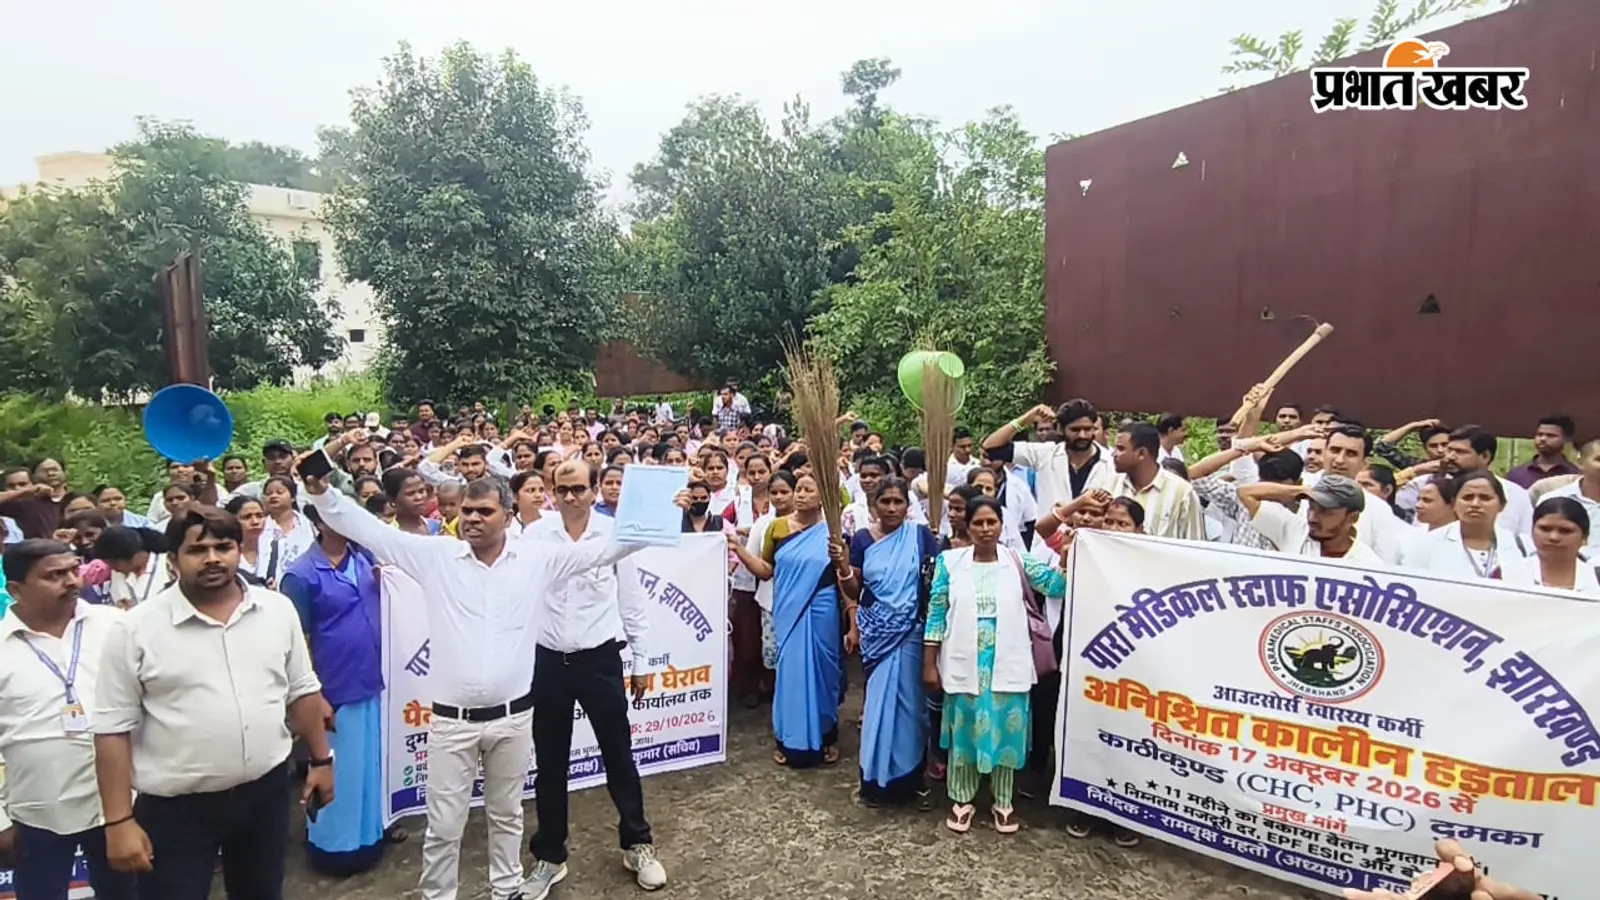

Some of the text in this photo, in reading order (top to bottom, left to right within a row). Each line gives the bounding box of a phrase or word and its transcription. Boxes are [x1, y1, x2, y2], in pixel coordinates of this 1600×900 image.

[1080, 621, 1136, 670] पारा
[1114, 578, 1227, 639] मेडिकल
[1223, 574, 1309, 608] स्टाफ
[1315, 575, 1505, 673] एसोसिएशन,
[1267, 619, 1300, 671] PARAMEDICAL
[1302, 616, 1343, 629] STAFFS
[661, 664, 712, 689] घेराव
[690, 688, 712, 701] तक
[1287, 680, 1346, 696] JHARKHAND
[645, 710, 715, 733] 29/10/2026
[1083, 675, 1244, 740] अनिश्चित
[1251, 716, 1415, 777] कालीन
[1213, 685, 1303, 713] आउटसोर्स
[1376, 714, 1425, 739] कर्मी
[663, 740, 700, 757] (सचिव)
[1151, 722, 1223, 756] दिनांक
[1228, 746, 1257, 763] 17
[1263, 753, 1360, 787] अक्टूबर
[1366, 776, 1441, 808] 2026
[1098, 728, 1228, 784] काठीकुण्ड
[1237, 771, 1321, 809] (CHC,
[1335, 793, 1416, 832] PHC)
[1086, 785, 1140, 814] निवेदक
[1222, 835, 1271, 859] महतो
[1124, 782, 1179, 811] निम्नतम
[1183, 805, 1232, 830] मजदूरी
[1267, 831, 1302, 848] EPF
[1307, 842, 1354, 865] ESIC
[1360, 857, 1395, 873] और
[1164, 785, 1181, 799] 11
[1187, 792, 1230, 815] महीने
[1234, 809, 1258, 824] का
[1262, 818, 1320, 841] बकाया
[1262, 802, 1308, 823] प्रमुख
